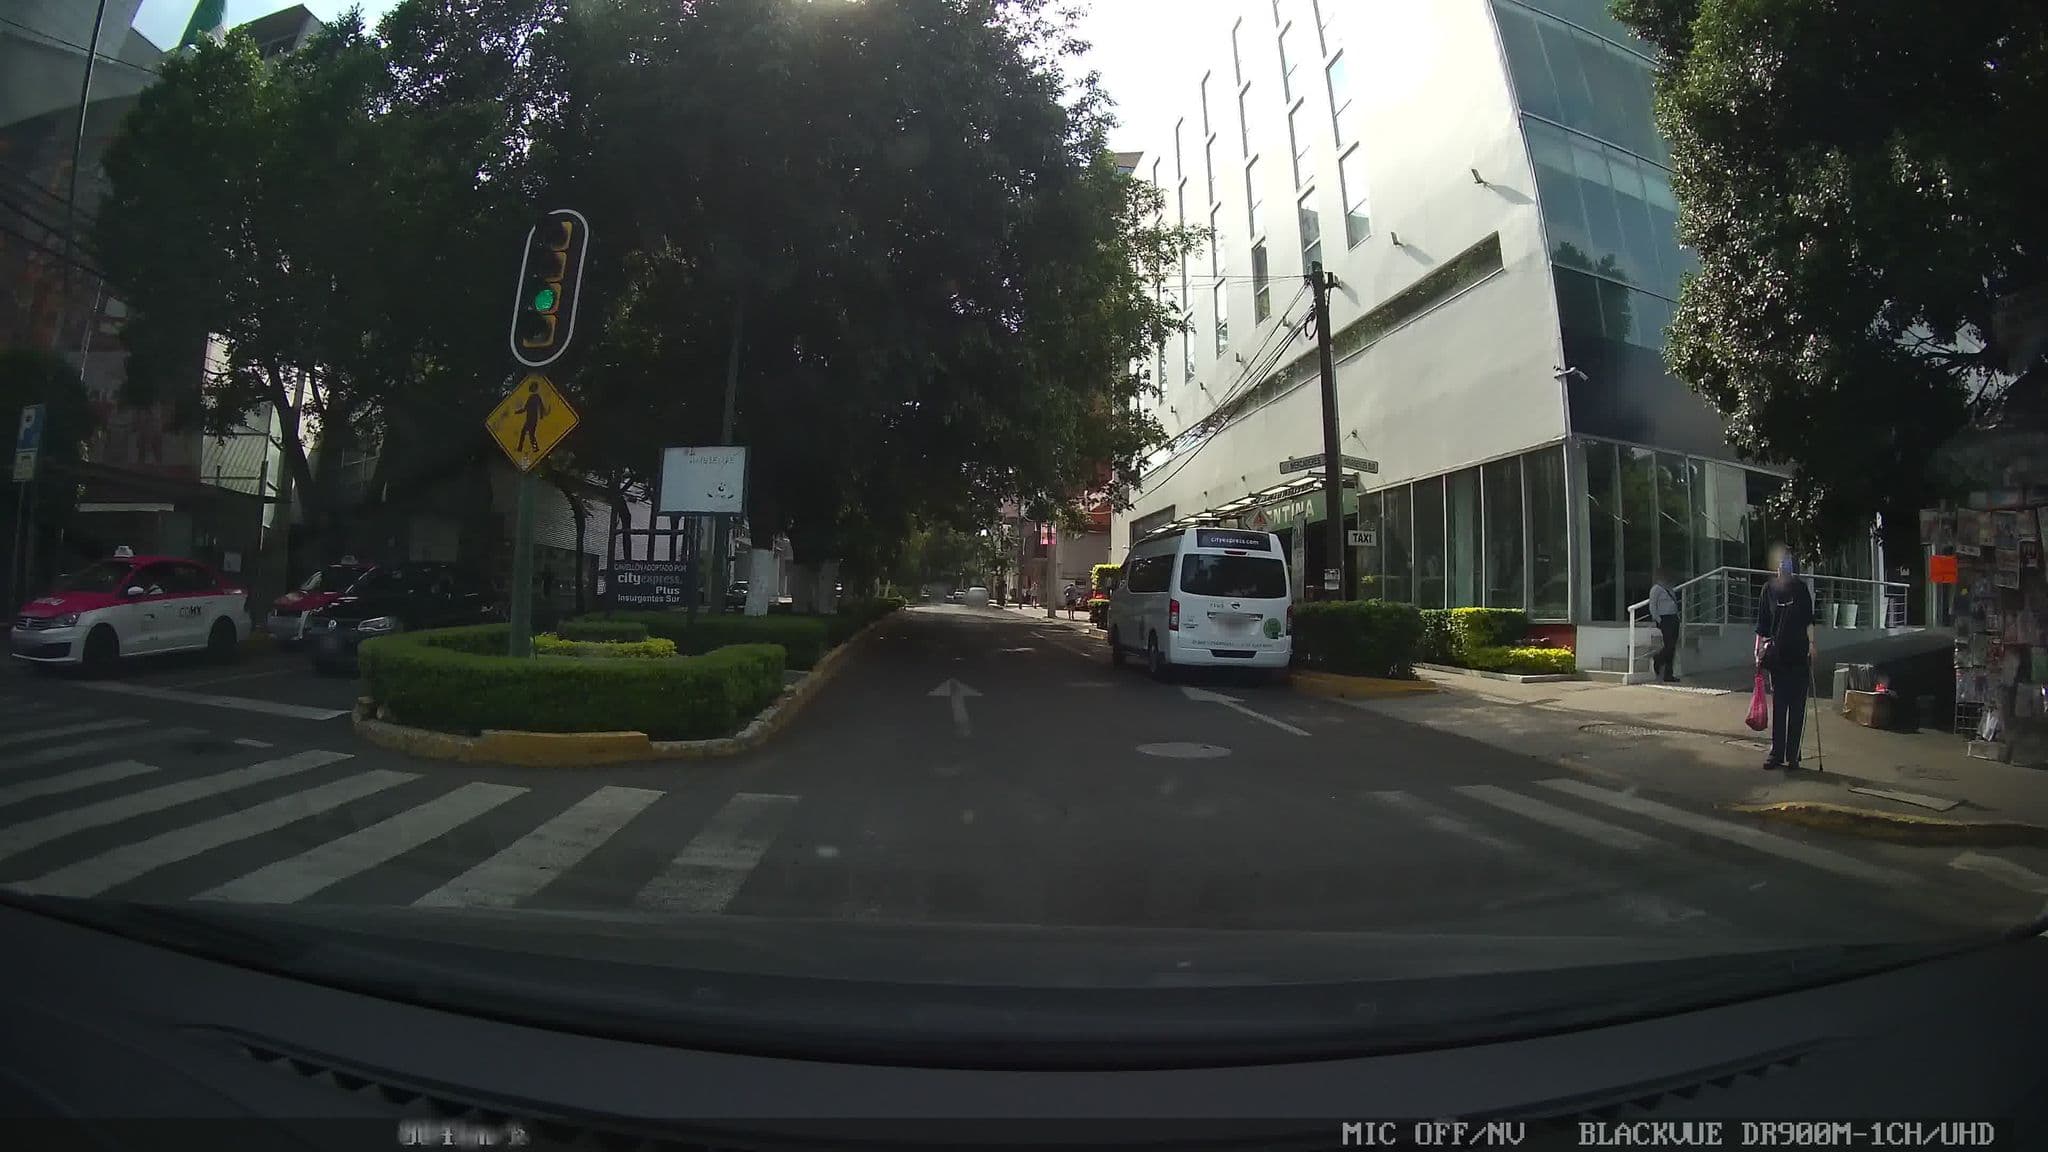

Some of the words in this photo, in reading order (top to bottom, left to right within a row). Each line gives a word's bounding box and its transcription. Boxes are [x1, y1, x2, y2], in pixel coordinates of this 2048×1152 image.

[1352, 533, 1373, 544] TAXI
[655, 586, 681, 595] Plus
[617, 594, 664, 604] Insurgentes
[665, 594, 681, 603] Sur
